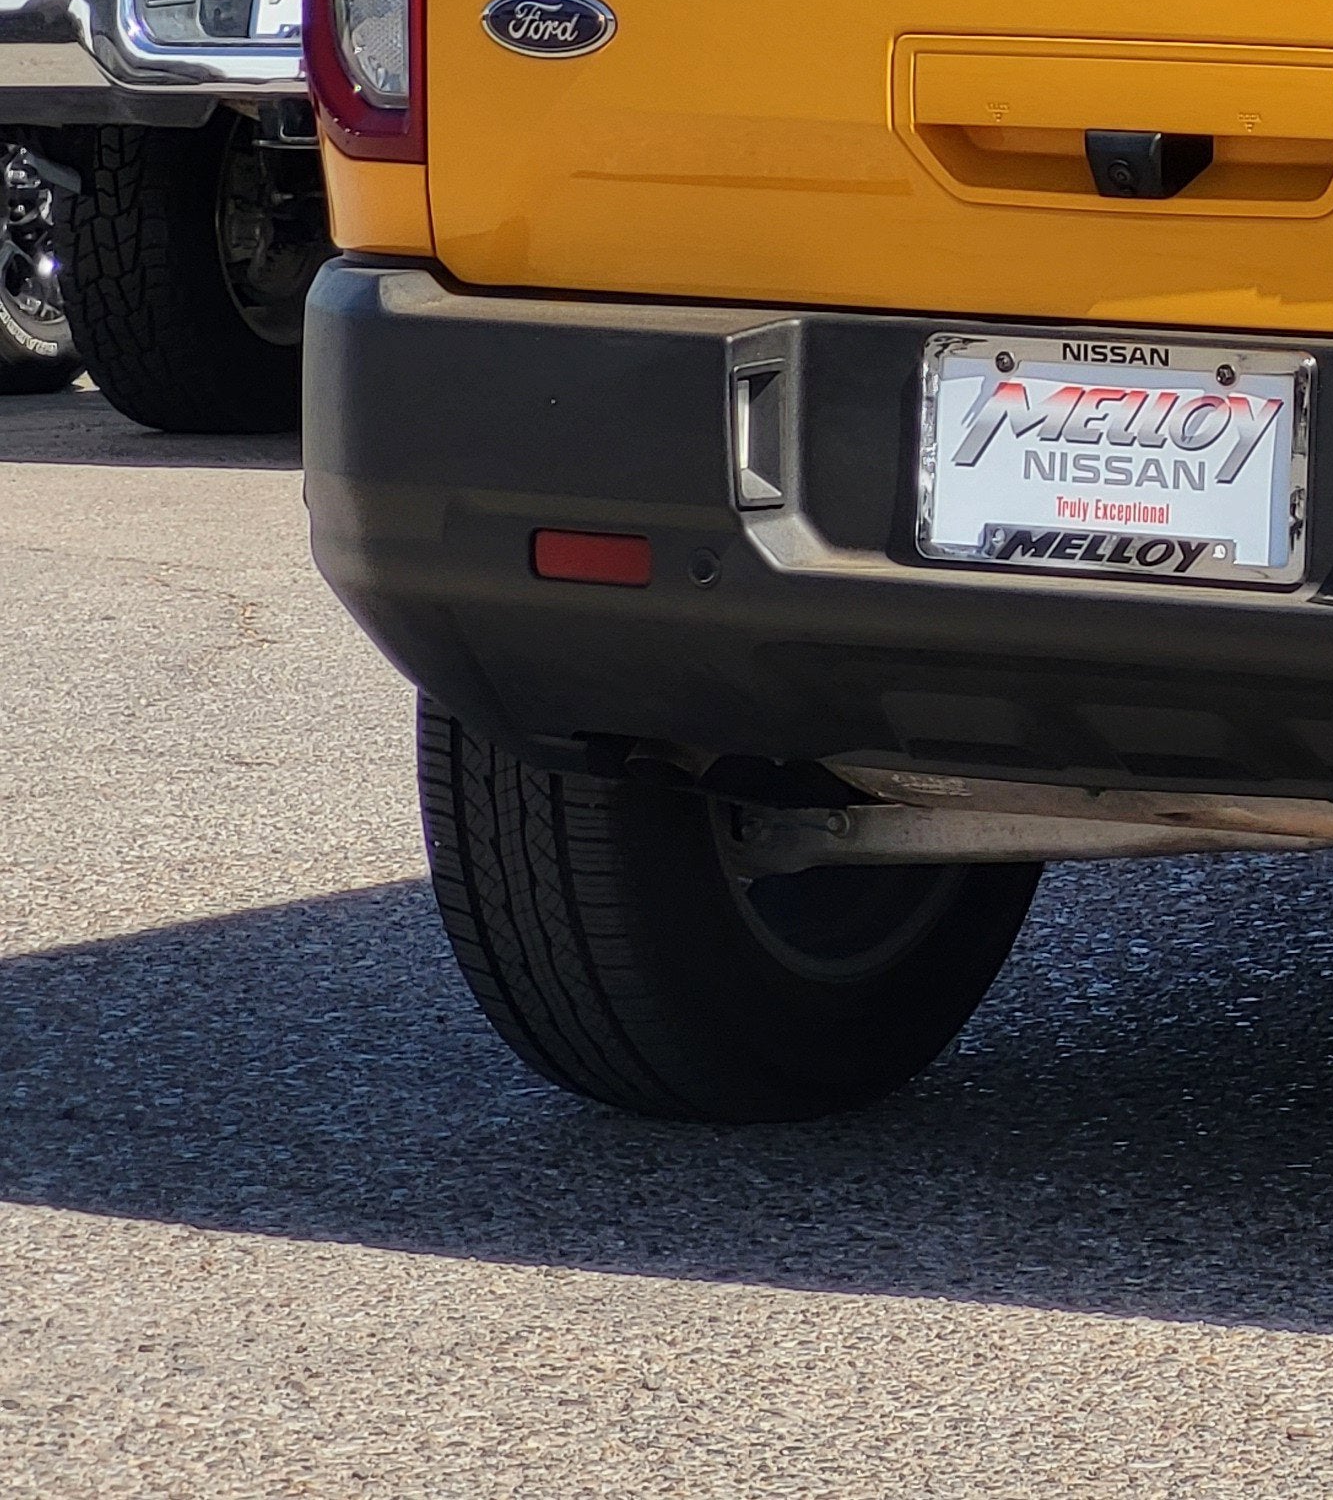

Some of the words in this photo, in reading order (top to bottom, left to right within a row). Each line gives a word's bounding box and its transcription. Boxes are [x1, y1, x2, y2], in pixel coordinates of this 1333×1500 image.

[508, 1, 580, 30] Ford
[1062, 343, 1170, 367] NISSAN
[952, 381, 1284, 484] MELLOY
[1024, 450, 1205, 491] NISSAN
[1056, 496, 1089, 522] Truly
[1094, 499, 1170, 525] Exceptional
[999, 530, 1210, 572] MELLOY
